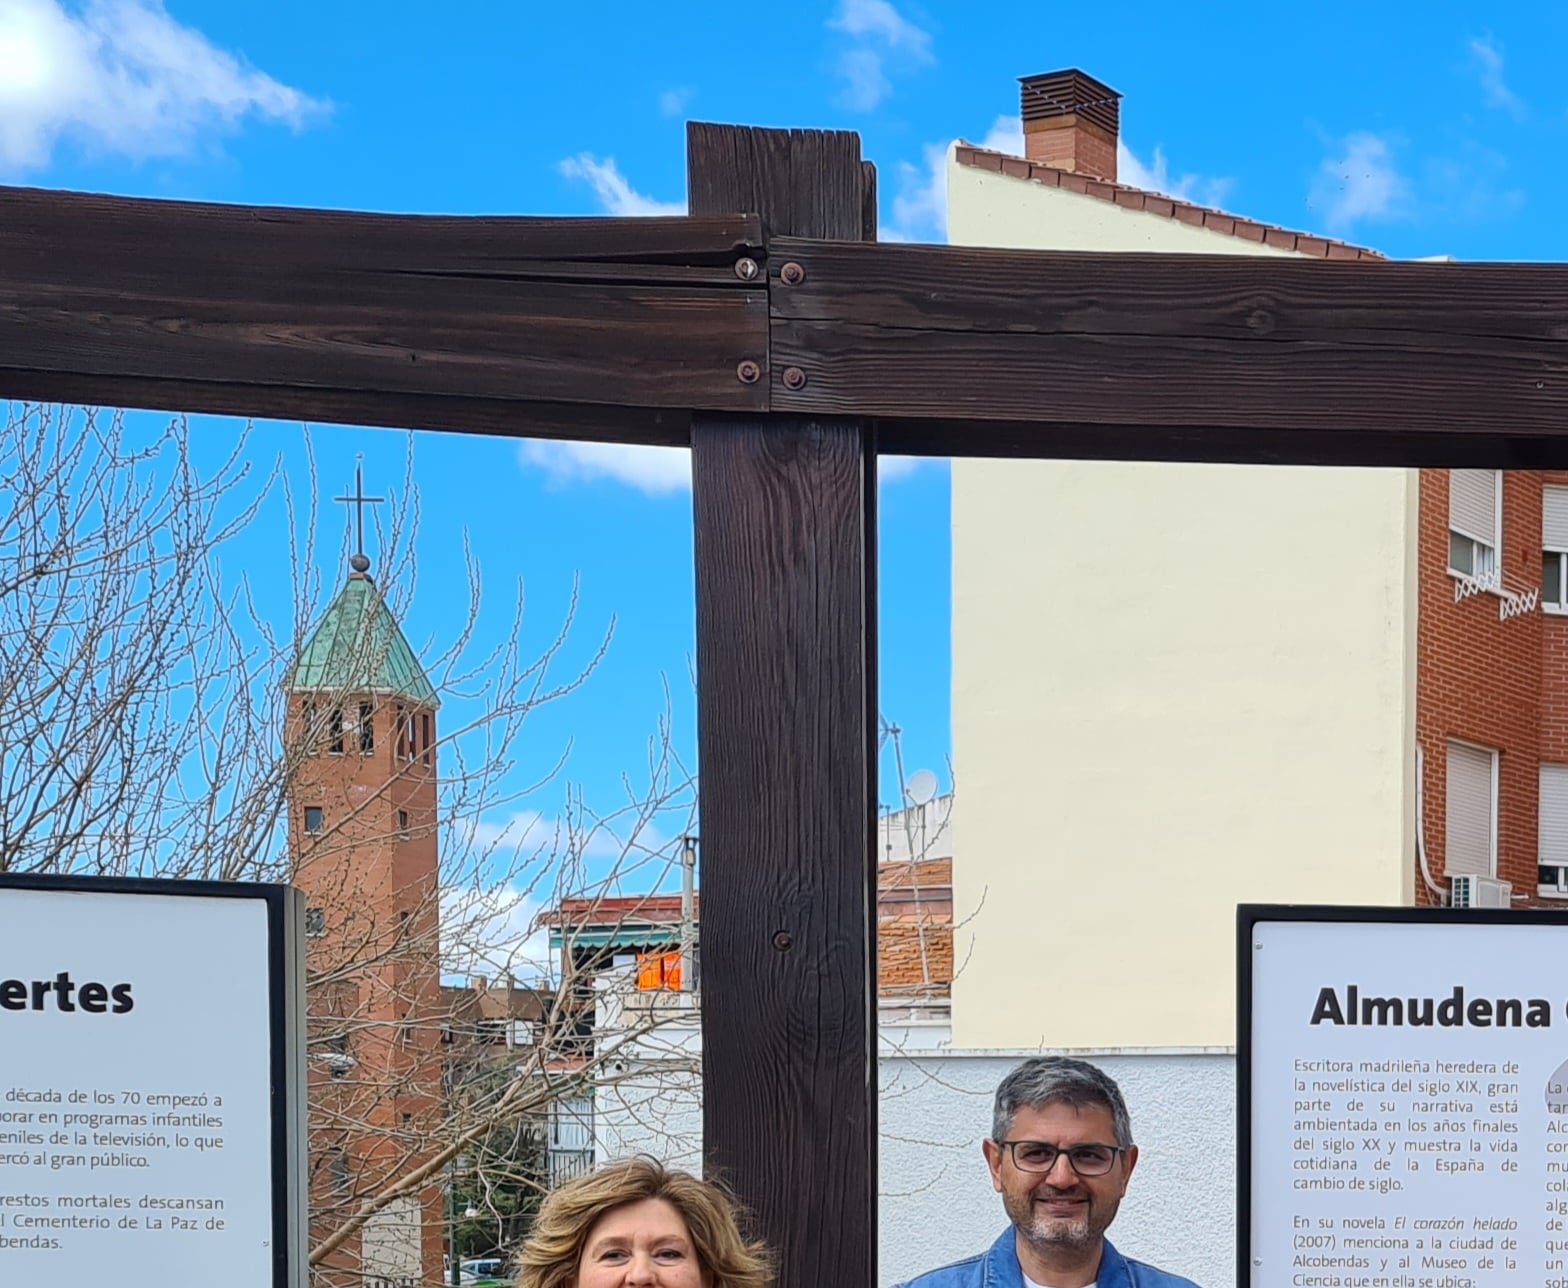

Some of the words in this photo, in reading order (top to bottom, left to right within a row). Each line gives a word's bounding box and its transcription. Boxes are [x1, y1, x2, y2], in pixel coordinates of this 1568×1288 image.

[0, 972, 134, 1014] ertes
[1310, 985, 1551, 1028] Almudena
[1295, 1059, 1353, 1072] Escritora
[1360, 1059, 1430, 1073] madrileña
[1436, 1059, 1496, 1073] heredera
[1502, 1060, 1519, 1074] de
[1295, 1078, 1306, 1091] la
[1312, 1078, 1385, 1092] novelística
[1391, 1079, 1412, 1092] del
[1418, 1079, 1450, 1096] siglo
[1456, 1080, 1481, 1095] XIX,
[1487, 1083, 1518, 1097] gran
[1546, 1080, 1562, 1095] La
[5, 1088, 62, 1103] década
[68, 1089, 88, 1103] de
[94, 1089, 115, 1104] los
[121, 1091, 141, 1105] 70
[146, 1092, 208, 1109] empezó
[214, 1096, 222, 1106] a
[1294, 1098, 1331, 1115] parte
[1346, 1098, 1364, 1111] de
[1380, 1102, 1395, 1112] su
[1412, 1099, 1473, 1113] narrativa
[1489, 1100, 1518, 1113] está
[0, 1112, 34, 1123] orar
[38, 1113, 58, 1123] en
[64, 1114, 147, 1129] programas
[152, 1112, 223, 1127] infantiles
[1294, 1117, 1378, 1131] ambientada
[1384, 1121, 1401, 1131] en
[1408, 1118, 1427, 1132] los
[1433, 1119, 1466, 1132] años
[1473, 1119, 1518, 1133] finales
[49, 1130, 69, 1145] de
[74, 1131, 87, 1145] la
[93, 1131, 170, 1149] televisión,
[176, 1133, 189, 1147] lo
[194, 1137, 223, 1151] que
[1294, 1136, 1314, 1150] del
[1322, 1137, 1355, 1154] siglo
[1362, 1138, 1381, 1151] XX
[1388, 1141, 1396, 1154] y
[1404, 1139, 1461, 1152] muestra
[1470, 1138, 1481, 1152] la
[1489, 1139, 1518, 1152] vida
[33, 1151, 46, 1165] al
[51, 1155, 86, 1170] gran
[90, 1152, 150, 1170] público.
[1293, 1156, 1357, 1170] cotidiana
[1374, 1157, 1391, 1170] de
[1408, 1158, 1419, 1171] la
[1436, 1158, 1484, 1175] España
[1501, 1158, 1518, 1172] de
[1294, 1176, 1345, 1189] cambio
[1348, 1176, 1365, 1190] de
[1369, 1177, 1403, 1193] siglo.
[0, 1193, 49, 1207] restos
[58, 1194, 131, 1208] mortales
[138, 1194, 224, 1209] descansan
[13, 1214, 110, 1229] Cementerio
[118, 1215, 138, 1229] de
[146, 1216, 162, 1229] La
[171, 1216, 198, 1230] Paz
[205, 1216, 224, 1230] de
[1294, 1215, 1310, 1228] En
[1318, 1218, 1334, 1229] su
[1343, 1216, 1385, 1229] novela
[1394, 1216, 1406, 1229] El
[1413, 1216, 1464, 1230] corazón
[1473, 1216, 1518, 1230] helado
[1546, 1217, 1563, 1231] de
[0, 1234, 63, 1249] bendas.
[1293, 1234, 1336, 1250] (2007)
[1343, 1235, 1409, 1249] menciona
[1416, 1239, 1424, 1249] a
[1431, 1236, 1442, 1249] la
[1449, 1236, 1494, 1250] ciudad
[1500, 1237, 1517, 1250] de
[1293, 1254, 1370, 1268] Alcobendas
[1380, 1258, 1388, 1271] y
[1399, 1255, 1410, 1268] al
[1422, 1256, 1467, 1269] Museo
[1478, 1256, 1494, 1269] de
[1505, 1256, 1516, 1269] la
[1546, 1260, 1563, 1270] un
[1293, 1273, 1341, 1287] Ciencia
[1372, 1278, 1389, 1287] en
[1392, 1274, 1415, 1288] ella
[1419, 1278, 1433, 1288] se
[1436, 1275, 1476, 1288] ubica:
